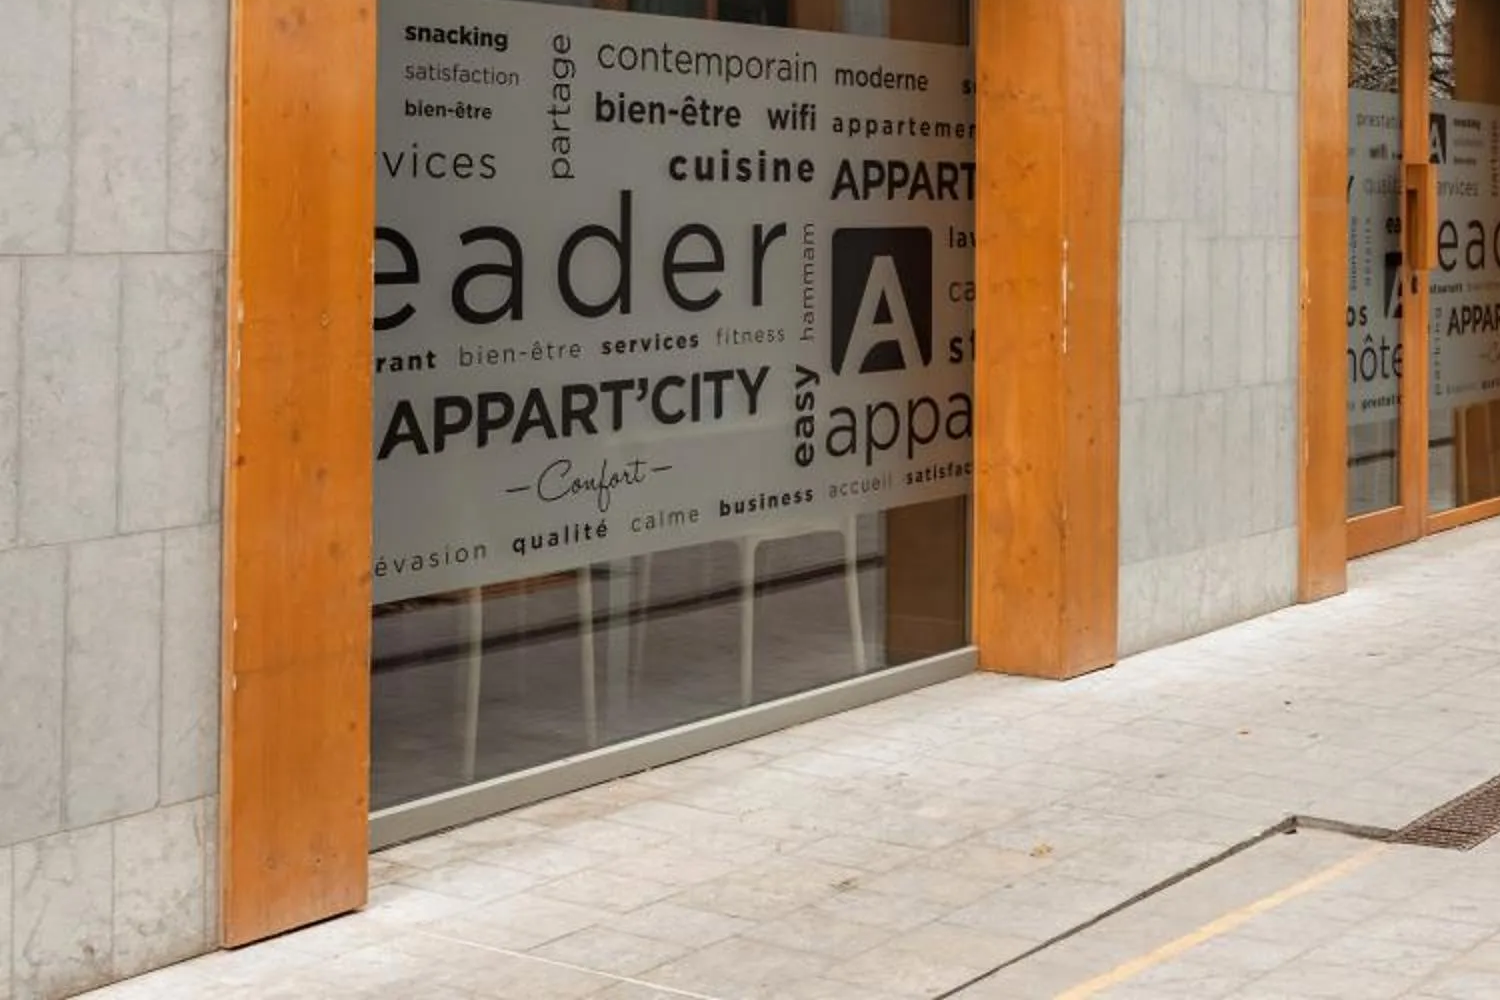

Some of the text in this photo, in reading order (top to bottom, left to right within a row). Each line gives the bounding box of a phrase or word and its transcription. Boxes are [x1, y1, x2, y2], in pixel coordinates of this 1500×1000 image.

[404, 25, 508, 52] snacking
[405, 63, 520, 86] satisfaction
[597, 42, 817, 84] contemporain
[835, 65, 928, 91] moderne
[404, 99, 493, 120] bien-être
[547, 34, 576, 179] partage
[595, 91, 741, 127] bien-être
[767, 103, 816, 131] wifi
[382, 143, 497, 179] vices
[669, 149, 814, 183] cuisine
[374, 190, 787, 331] eader
[800, 222, 815, 341] hammam
[838, 254, 928, 376] A
[376, 327, 785, 373] rant bien-être services fitness
[795, 364, 820, 467] easy
[537, 456, 648, 513] Confort
[374, 542, 487, 577] évasion
[512, 519, 608, 555] qualité
[631, 506, 699, 533] calme
[719, 488, 814, 517] business
[828, 473, 892, 499] accueil
